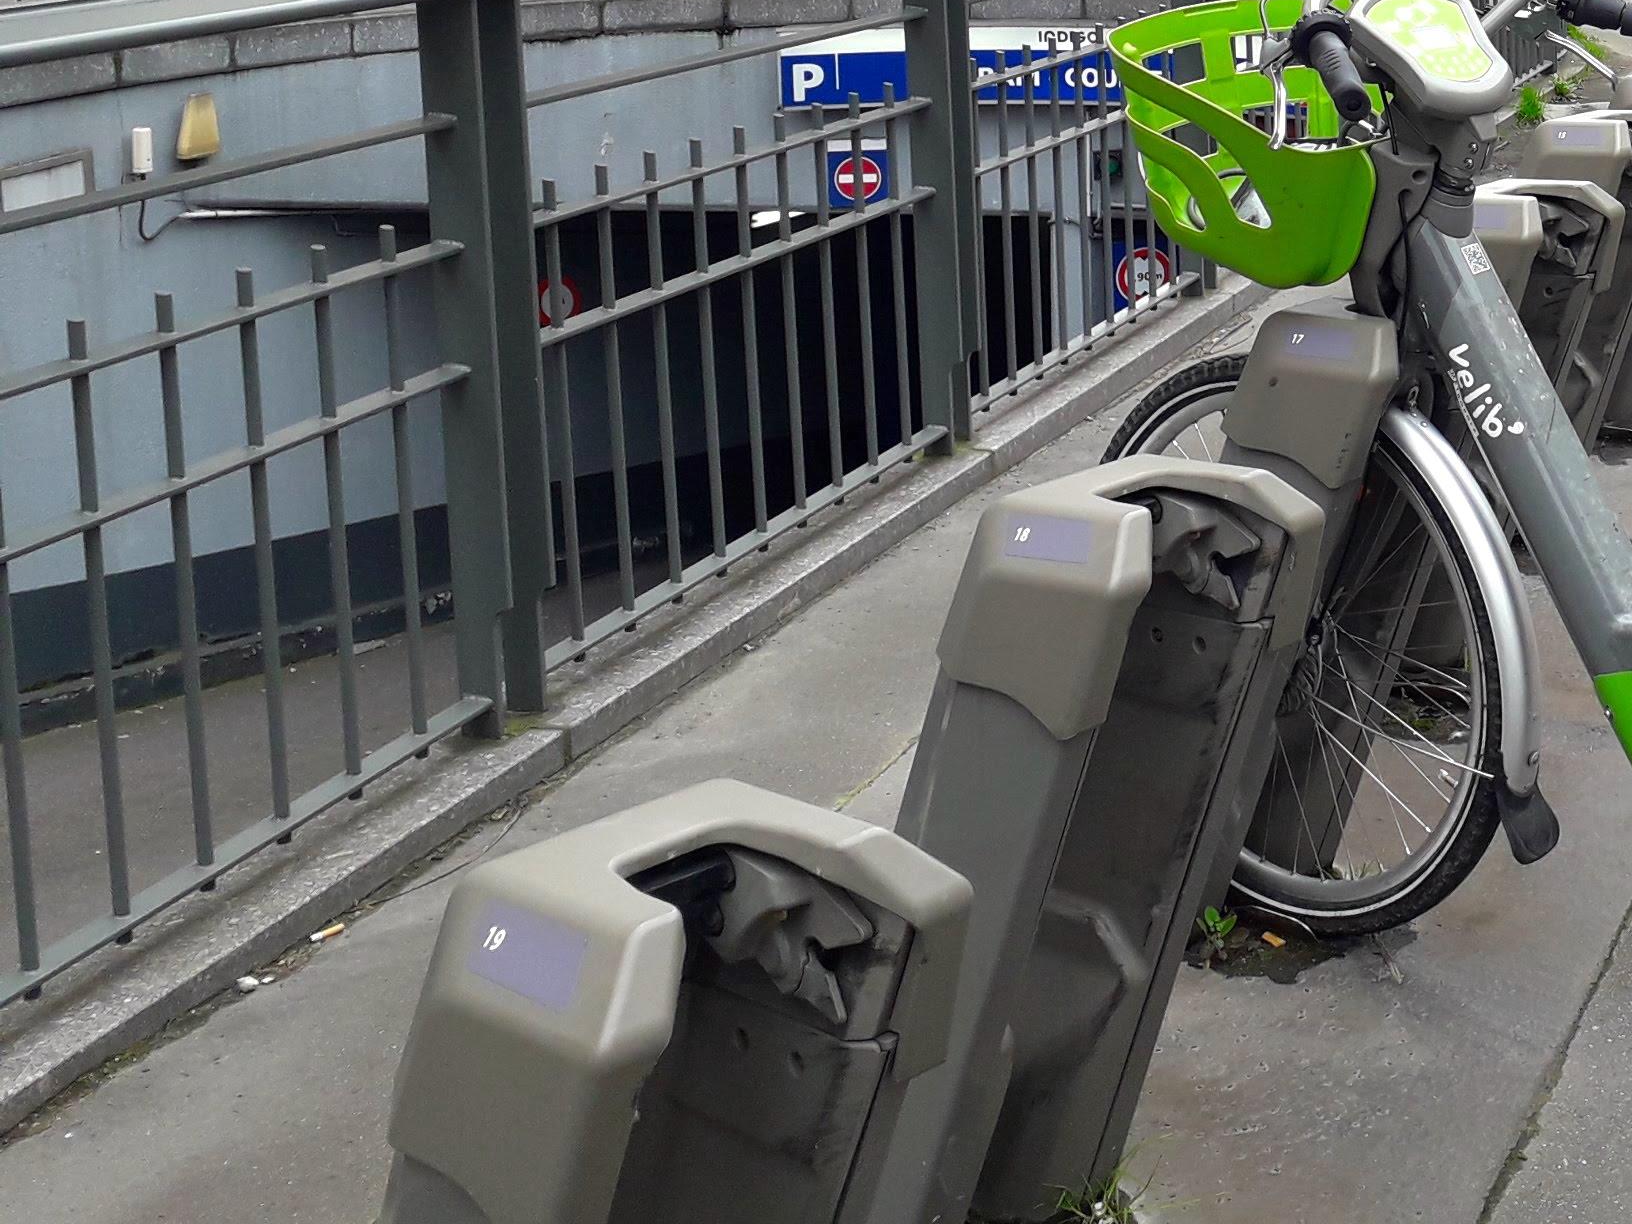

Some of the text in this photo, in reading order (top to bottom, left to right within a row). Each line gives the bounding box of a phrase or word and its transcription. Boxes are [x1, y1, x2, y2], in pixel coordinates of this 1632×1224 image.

[1039, 30, 1097, 44] INDGO
[791, 63, 825, 104] P
[1291, 333, 1305, 344] 17
[1014, 527, 1031, 542] 18
[483, 926, 506, 950] 19
